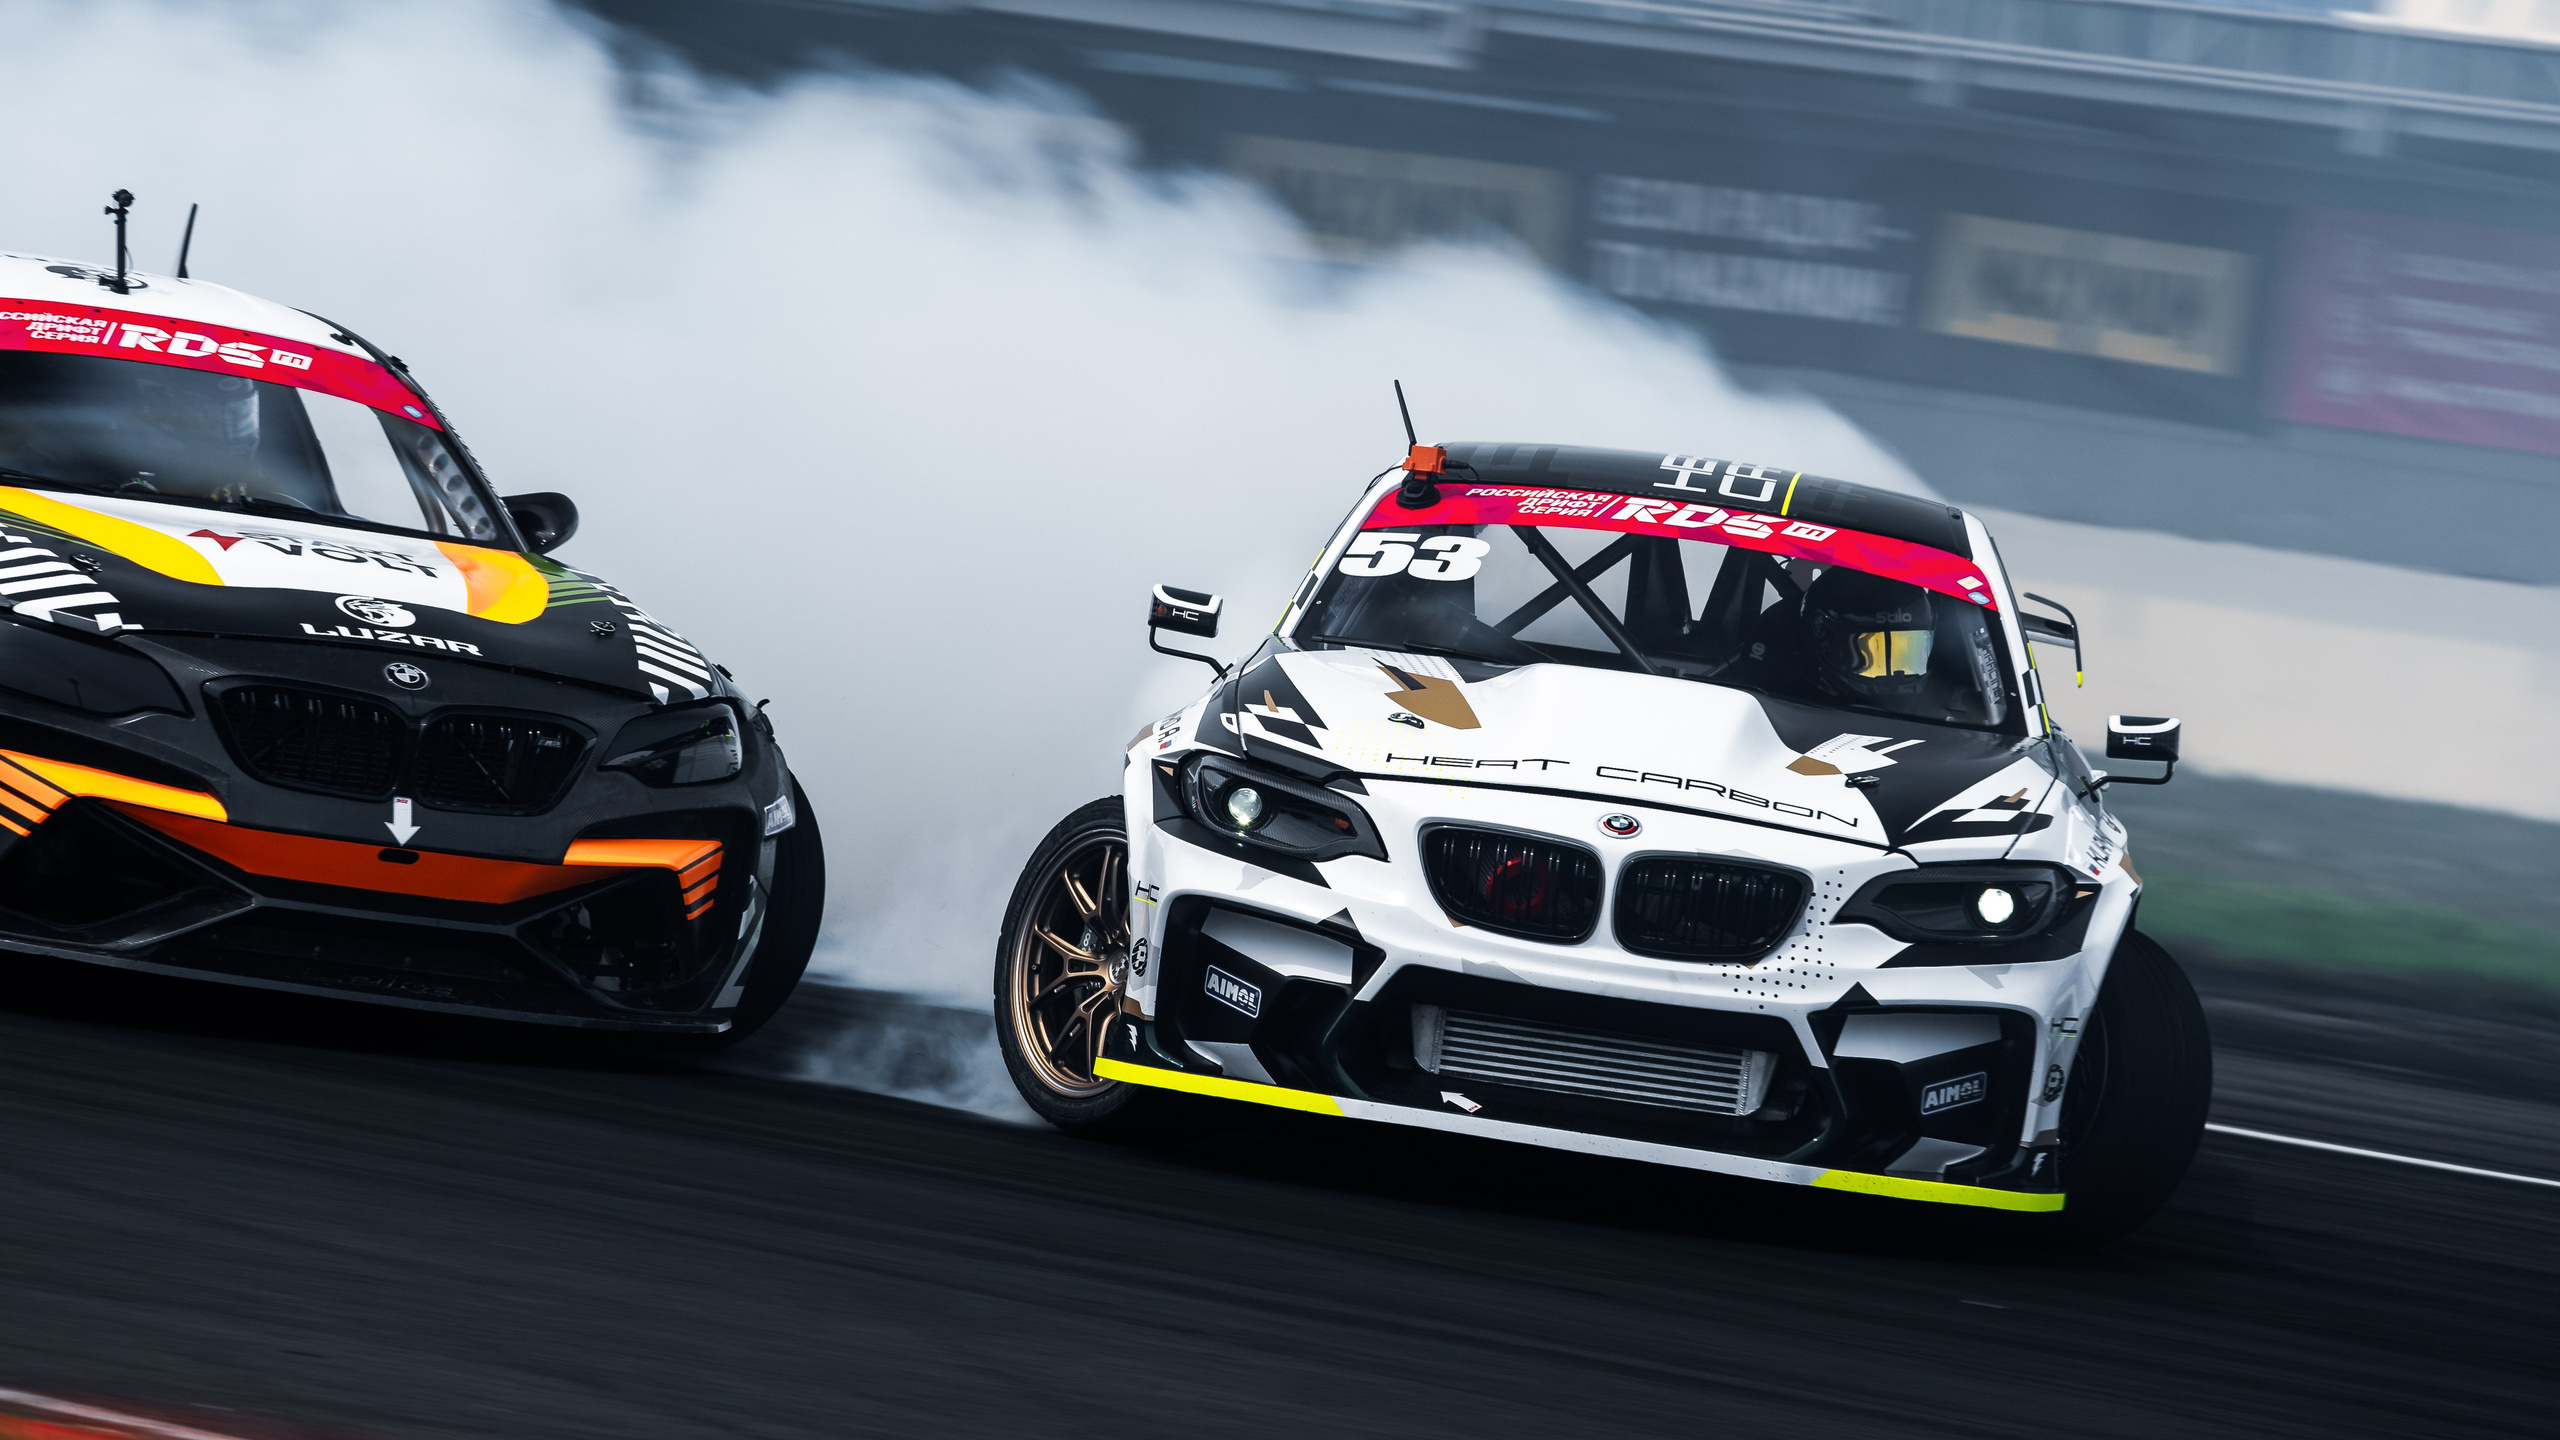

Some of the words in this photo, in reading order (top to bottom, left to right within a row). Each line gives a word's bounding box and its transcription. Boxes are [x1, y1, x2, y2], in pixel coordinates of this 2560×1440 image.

[26, 322, 103, 336] ДРИФТ
[30, 330, 100, 344] СЕРИЯ
[118, 323, 268, 368] RDS
[1465, 488, 1613, 503] РОССИЙСКАЯ
[1517, 497, 1603, 510] ДРИФТ
[1518, 506, 1594, 518] СЕРИЯ
[1611, 496, 1788, 539] RDS
[257, 541, 439, 578] VOLT
[1339, 532, 1491, 581] 53
[1172, 608, 1199, 621] HC
[1876, 608, 1912, 624] Stilo
[300, 623, 483, 656] LUZAR
[2123, 737, 2152, 746] HC
[1386, 753, 1570, 771] HEAT
[1596, 765, 1859, 827] CARBON
[1135, 880, 1160, 903] HC
[1207, 973, 1257, 1011] AIMOL
[2051, 1017, 2079, 1034] HC
[1924, 1079, 1983, 1109] AIMOL
